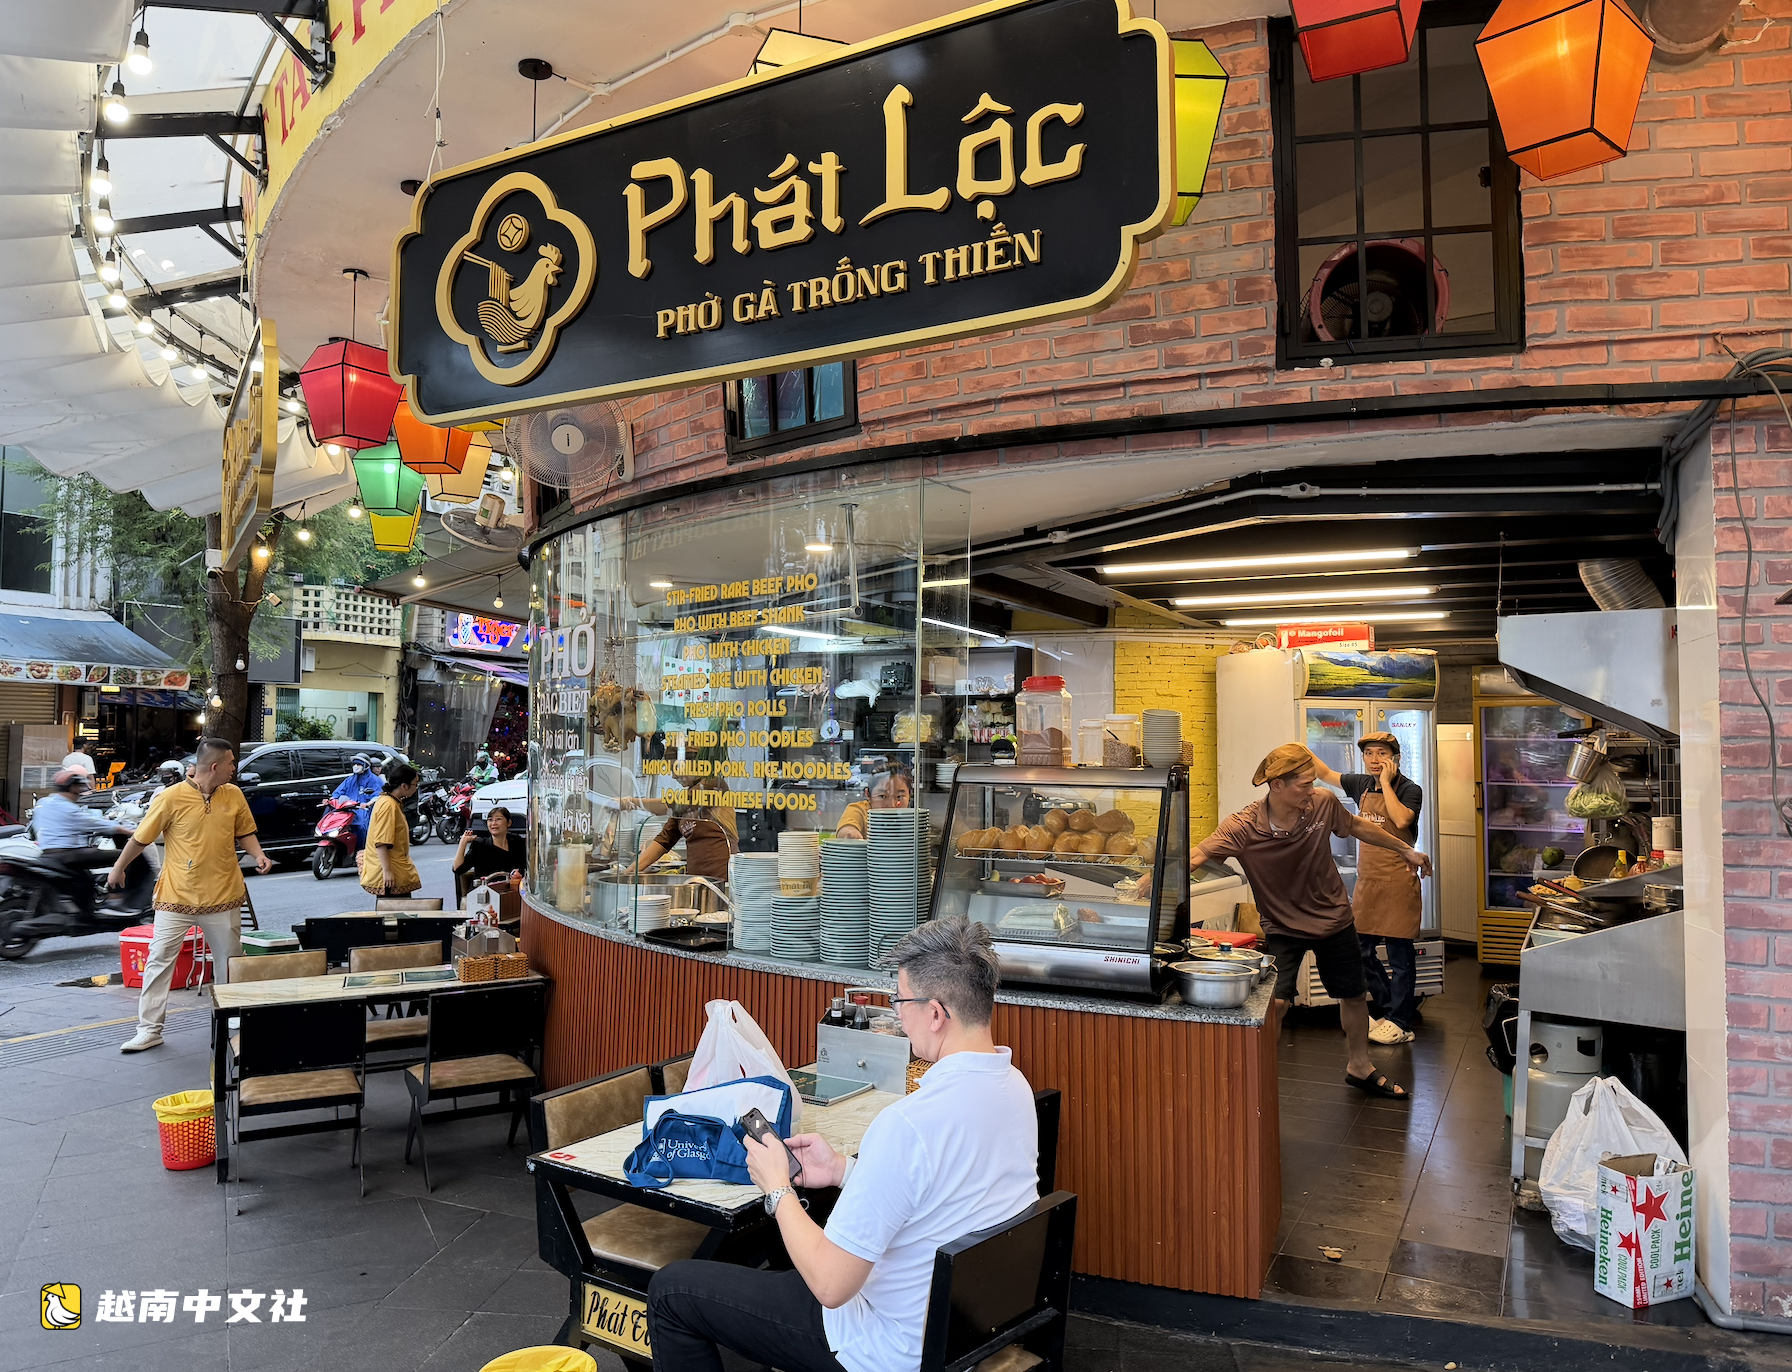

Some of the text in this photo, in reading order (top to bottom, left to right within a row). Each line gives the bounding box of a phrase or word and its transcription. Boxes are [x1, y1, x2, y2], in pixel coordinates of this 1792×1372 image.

[622, 83, 1087, 280] Phát Lộc
[733, 279, 781, 323] GÀ
[787, 255, 908, 312] TRỐNG
[918, 221, 1042, 285] THIẾN
[666, 572, 818, 607] STIR-FRIED RARE BEEF PHO
[674, 605, 806, 634] PHO WITH BEEF SHANK
[1298, 627, 1344, 639] Mangofoil
[540, 607, 596, 681] PHỞ
[683, 636, 790, 661] PHO WITH CHICKEN
[660, 666, 823, 692] STEAMED RICE WITH CHICKEN
[558, 685, 591, 719] BIỆT
[684, 698, 787, 719] FRESH PHO ROLLS
[664, 729, 814, 748] STIR-FRIED PHO NOODLES
[642, 759, 852, 781] HANOI GRILLED PORK, RICE NOODLES
[660, 788, 817, 812] LOCAL VIETNAMESE FOODS
[562, 809, 573, 831] Hà
[575, 811, 591, 839] Nội
[1104, 955, 1141, 965] SHINICHI
[667, 1148, 679, 1162] of
[1674, 1169, 1694, 1265] Heine
[1598, 1206, 1613, 1286] Heineken
[1650, 1228, 1661, 1269] COOLPACK
[1617, 1253, 1628, 1292] COOLPACK
[1636, 1257, 1649, 1305] LIMITED EDITION
[1634, 1285, 1643, 1306] 250ML
[587, 1290, 629, 1337] Phát
